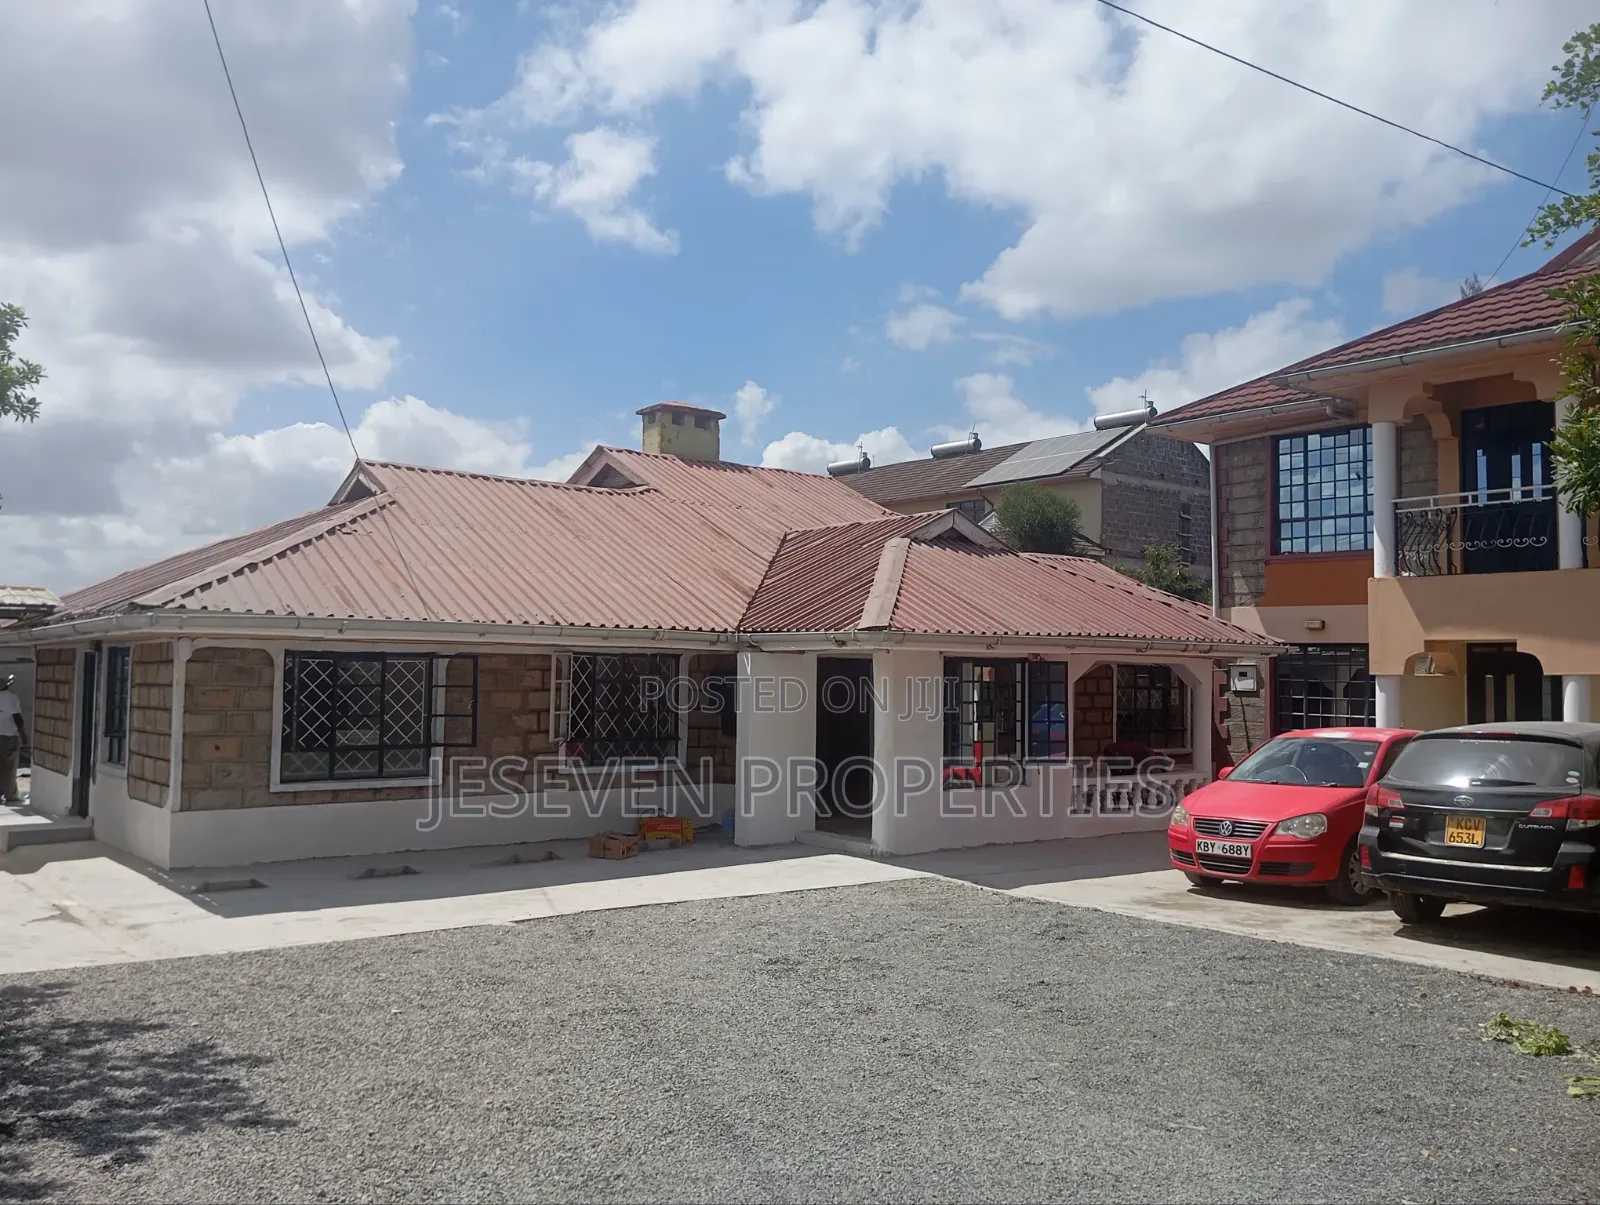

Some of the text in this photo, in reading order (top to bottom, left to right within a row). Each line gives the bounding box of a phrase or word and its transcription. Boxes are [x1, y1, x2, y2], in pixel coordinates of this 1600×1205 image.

[1456, 816, 1481, 831] KCV
[1448, 831, 1479, 845] 653L
[1197, 840, 1250, 857] KBY 688Y
